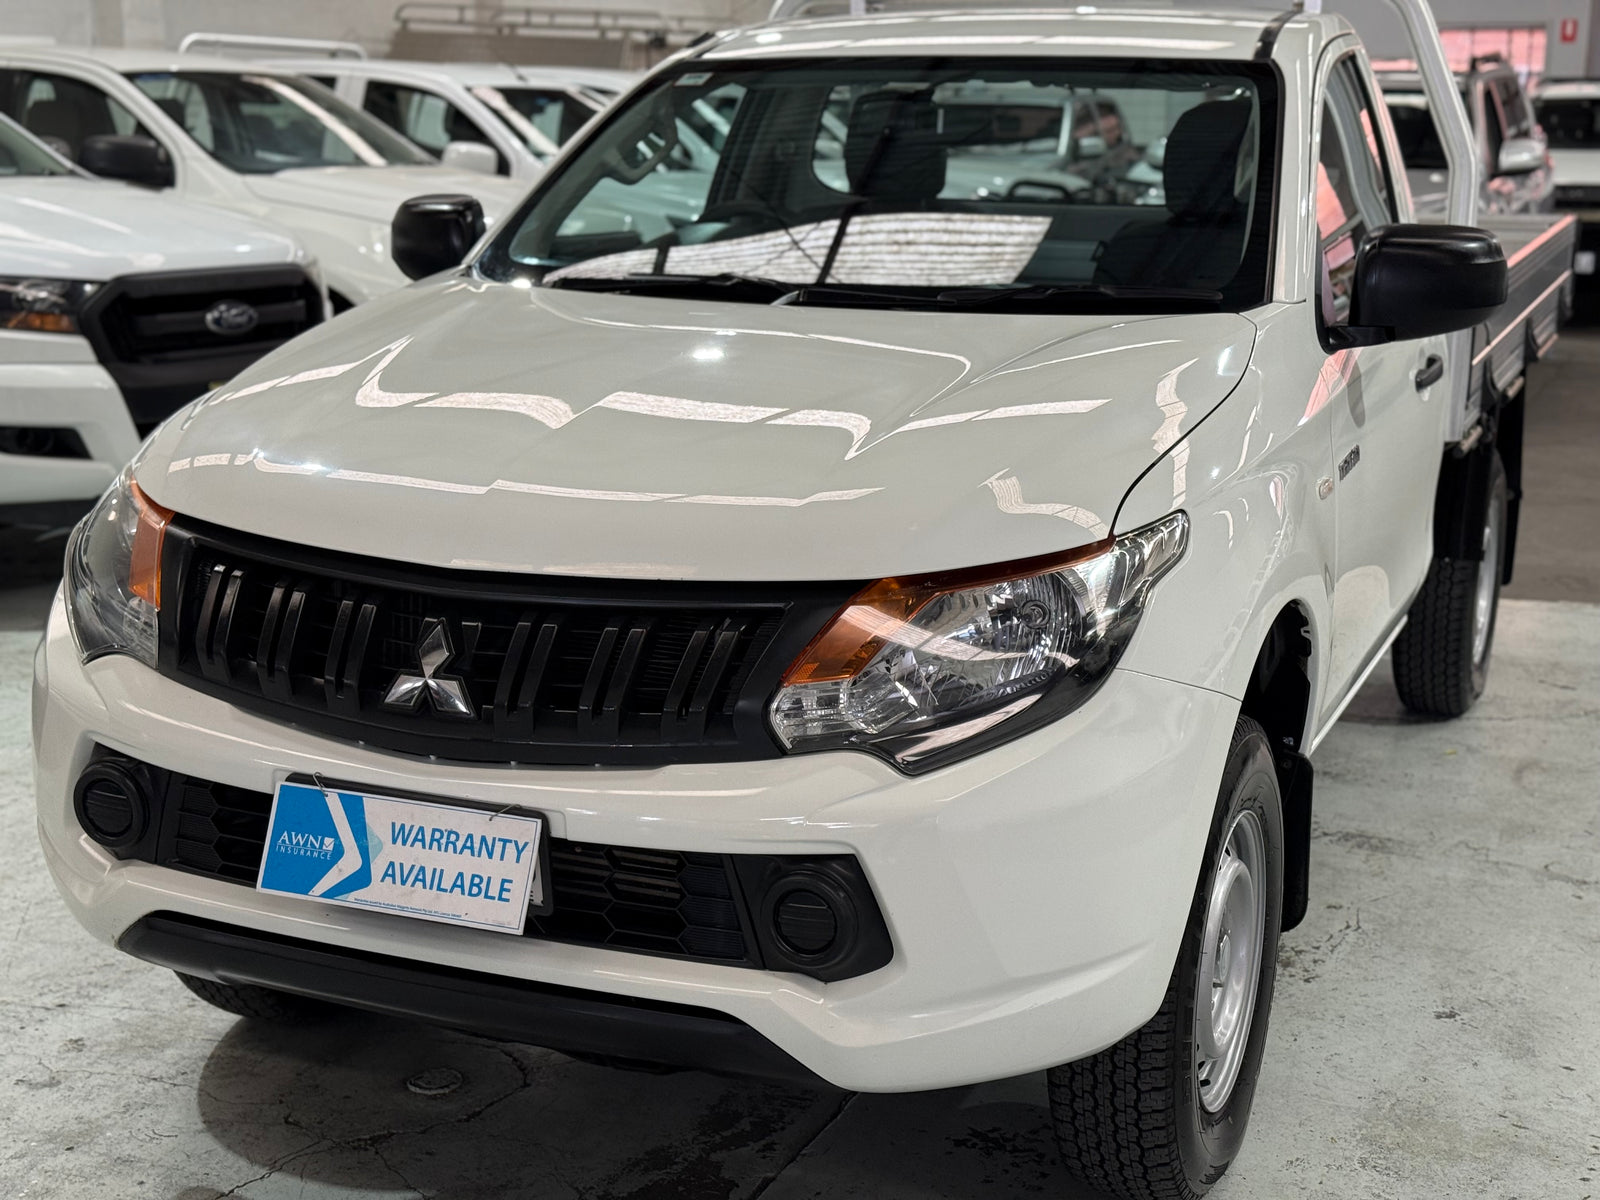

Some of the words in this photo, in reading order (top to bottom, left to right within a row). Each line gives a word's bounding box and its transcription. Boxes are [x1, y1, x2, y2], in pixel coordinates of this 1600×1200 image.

[276, 844, 332, 860] INSURANCE
[278, 830, 322, 849] AWN
[390, 821, 529, 864] WARRANTY
[380, 861, 513, 902] AVAILABLE
